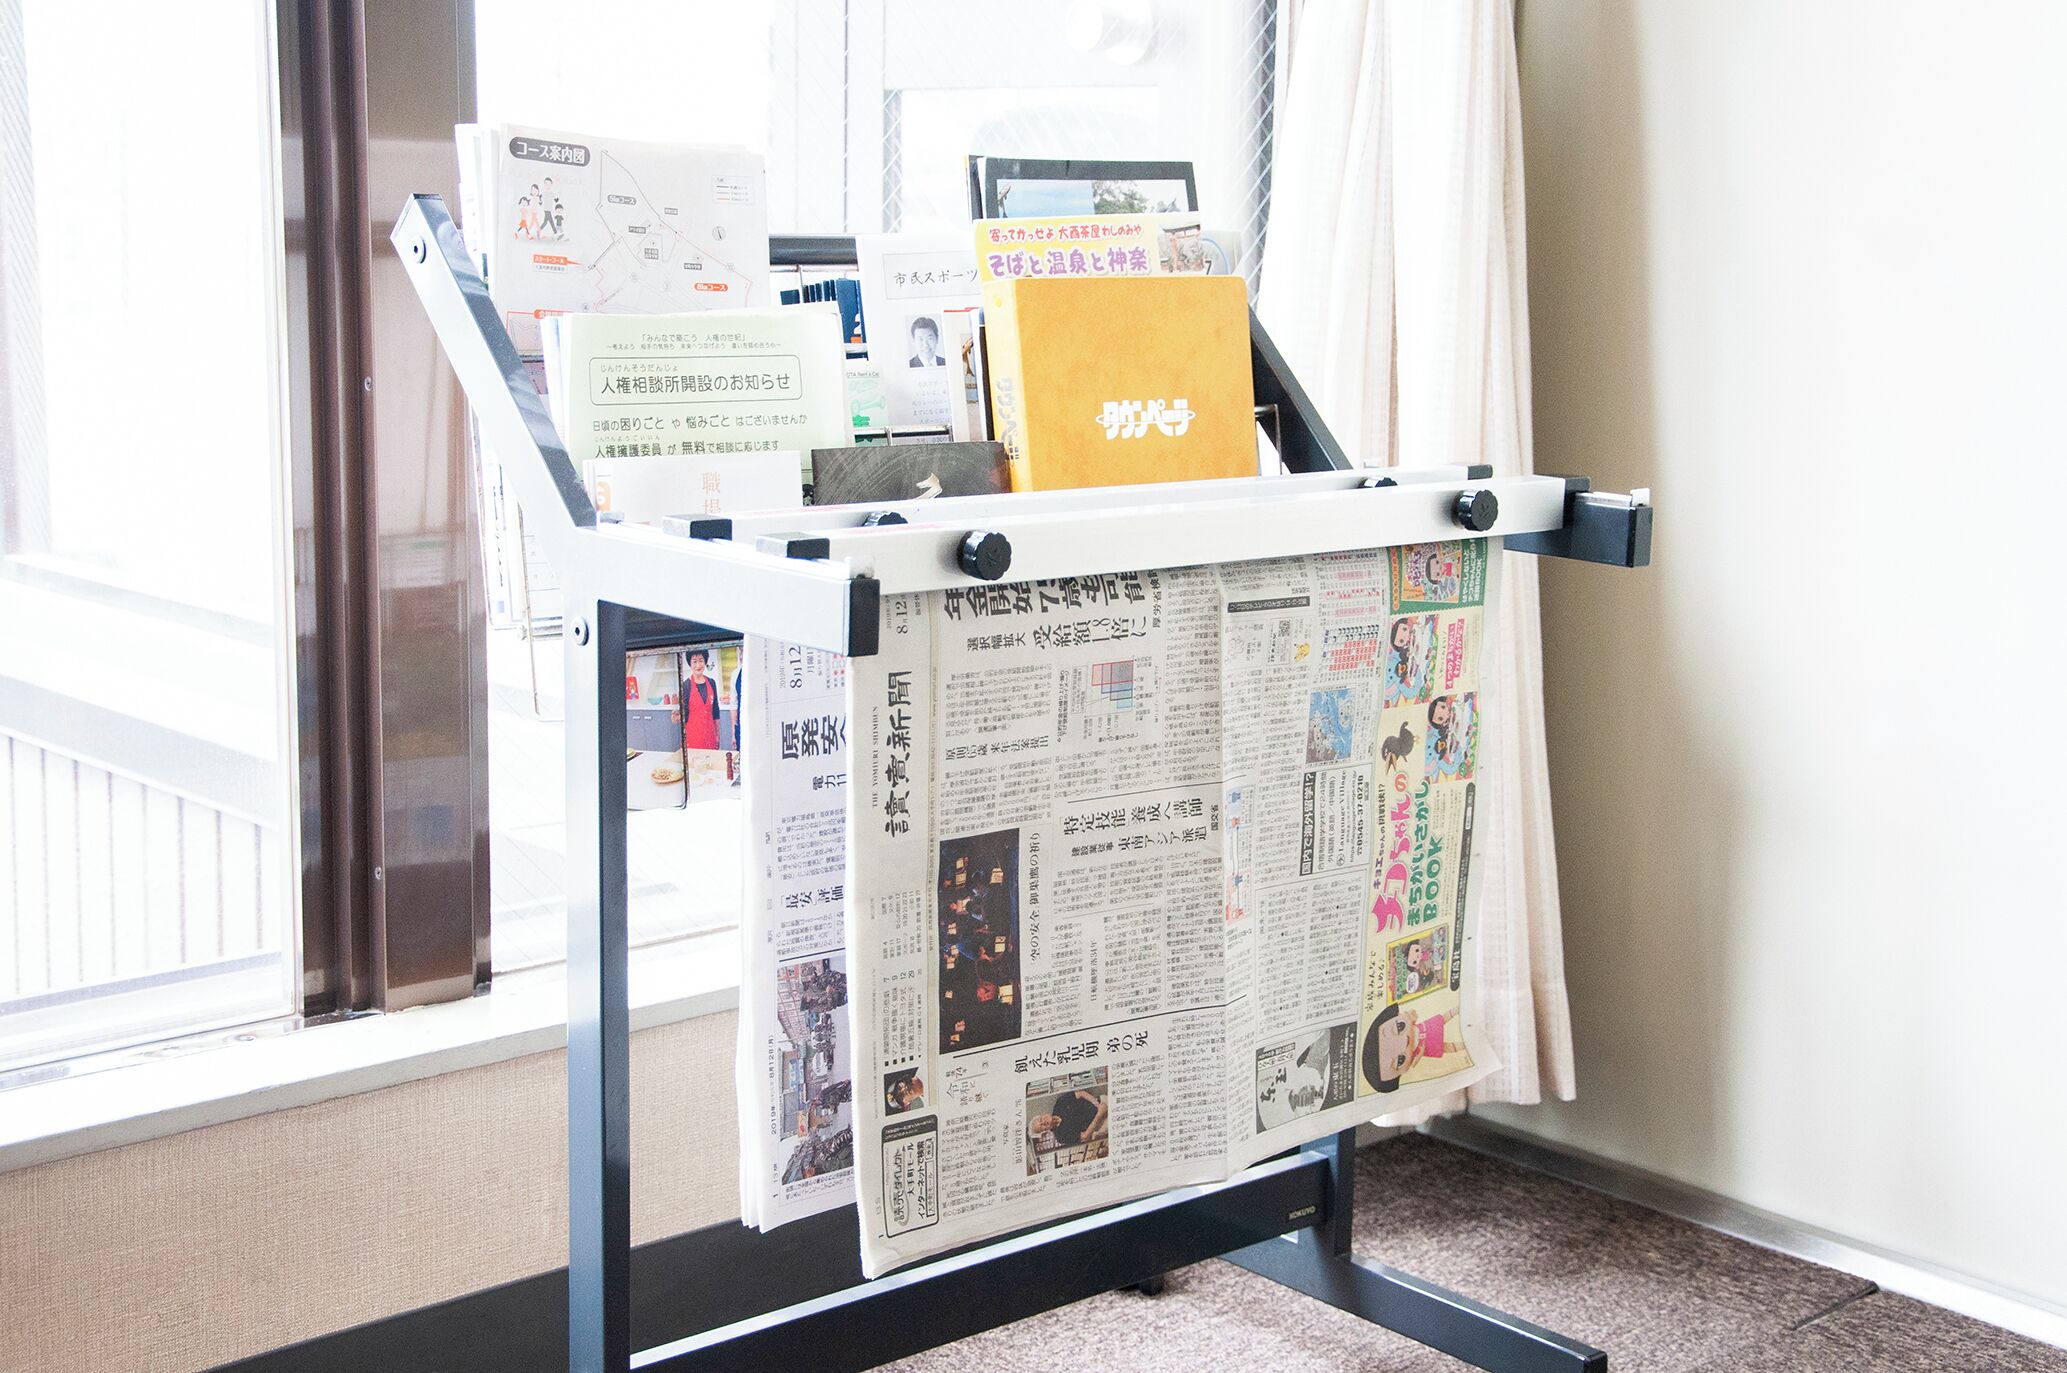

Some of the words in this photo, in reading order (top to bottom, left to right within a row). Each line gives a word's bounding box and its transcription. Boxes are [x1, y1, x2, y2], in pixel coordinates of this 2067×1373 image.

[516, 141, 585, 164] コース案内図
[988, 247, 1149, 278] そばと温泉と神楽
[600, 364, 679, 373] じんけんそうだんじょ
[601, 373, 791, 395] 人権相談所開設のお知らせ
[593, 416, 665, 432] 日頃の困りごと
[672, 418, 681, 429] や
[686, 414, 731, 430] 悩みごと
[595, 444, 662, 459] 人権擁護委員
[667, 444, 677, 456] が
[682, 439, 780, 455] 無料で相談に応じます
[967, 632, 1025, 652] 選択幅拡大
[1338, 770, 1346, 804] Village
[1210, 804, 1219, 831] 国交省
[1338, 806, 1346, 852] Language
[1117, 825, 1207, 851] 東南アジア派遣
[1371, 772, 1411, 933] チコちゃんの
[1406, 781, 1429, 926] まちがいさがし
[1422, 835, 1443, 923] BOOK
[1014, 1040, 1099, 1074] 飢えた乳児期
[1106, 1030, 1149, 1053] 弟の死
[907, 1143, 915, 1195] 大手町モール
[917, 1140, 925, 1219] インターネットで検索
